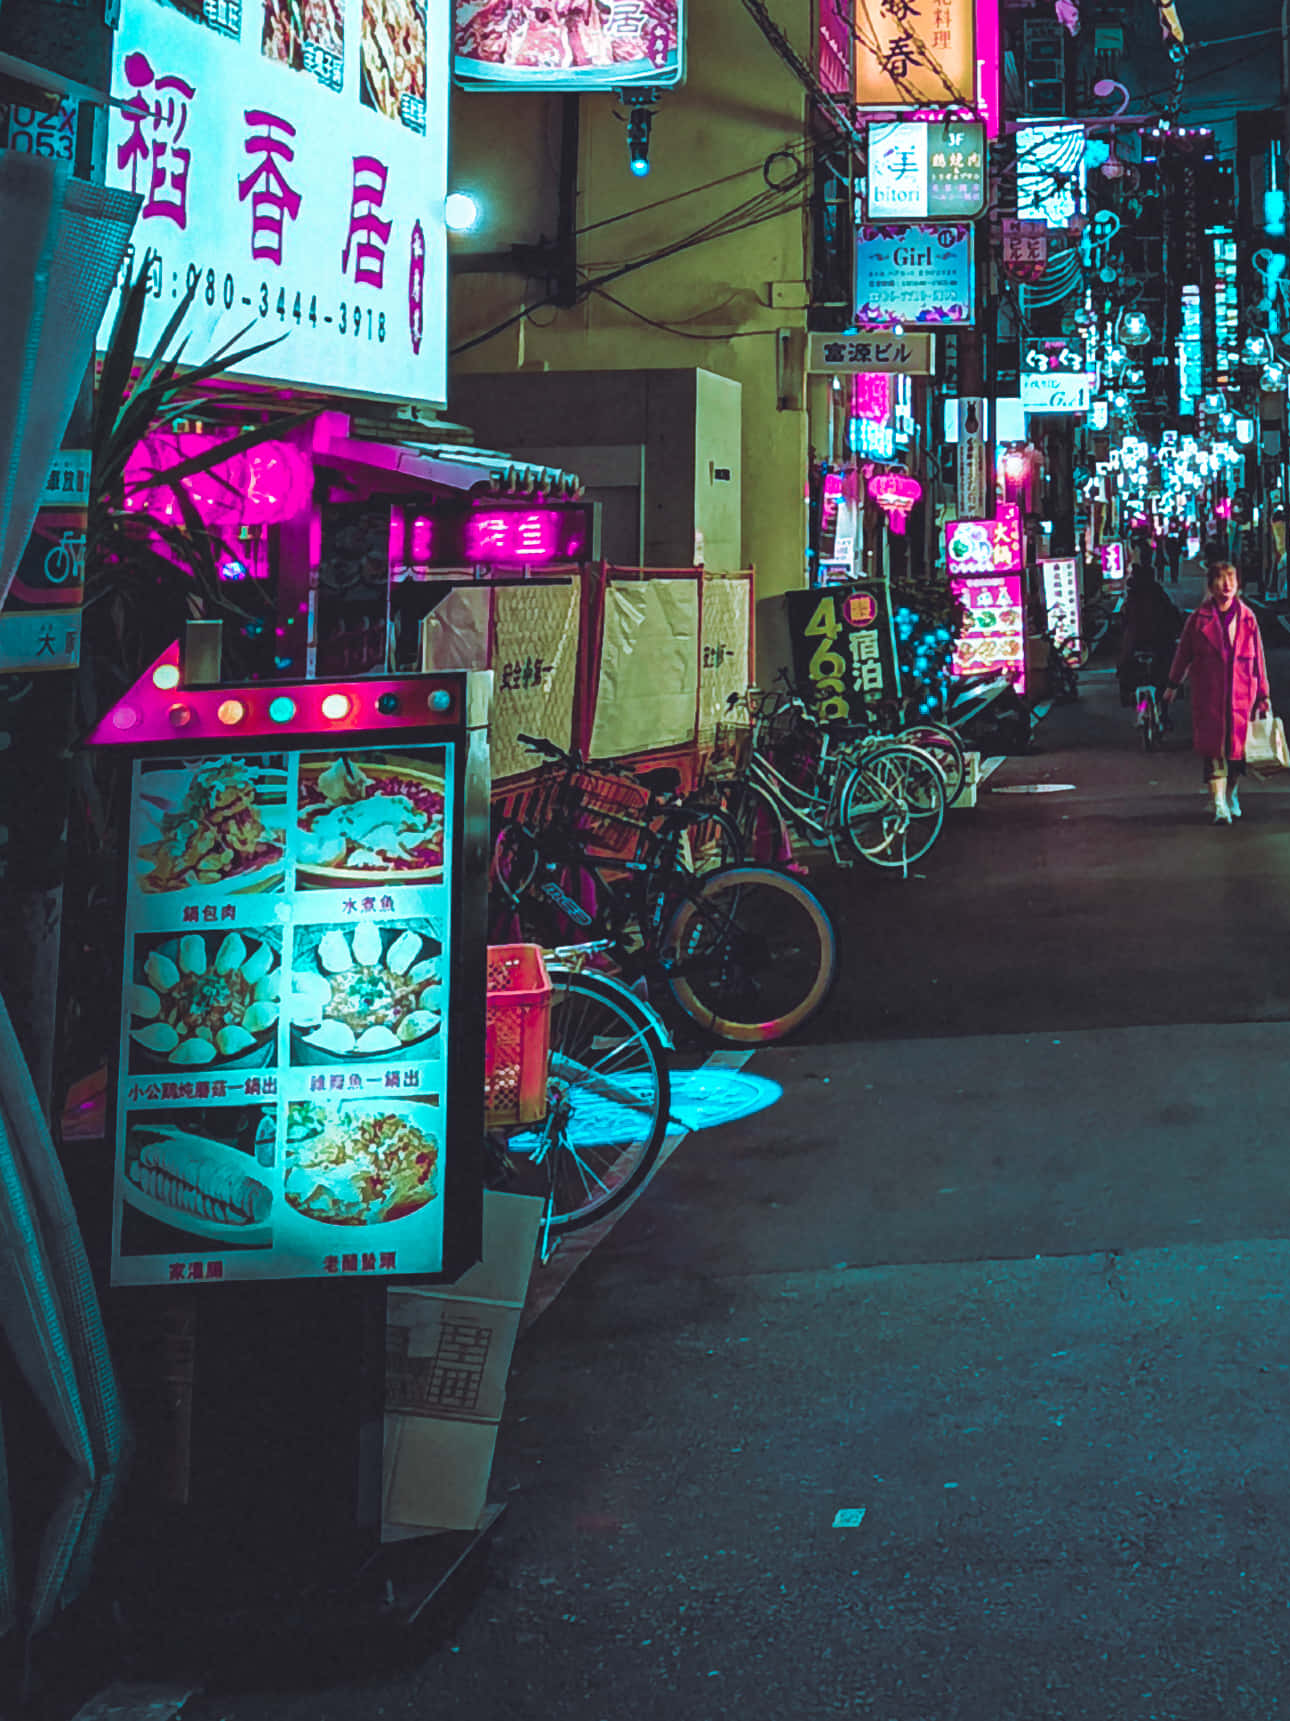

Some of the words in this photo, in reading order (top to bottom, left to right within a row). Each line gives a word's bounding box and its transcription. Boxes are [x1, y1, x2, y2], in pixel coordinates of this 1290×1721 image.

[892, 246, 932, 267] Girl
[823, 341, 914, 363] 富源ビル
[848, 628, 884, 692] 宿泊
[342, 894, 395, 915] 水煮魚
